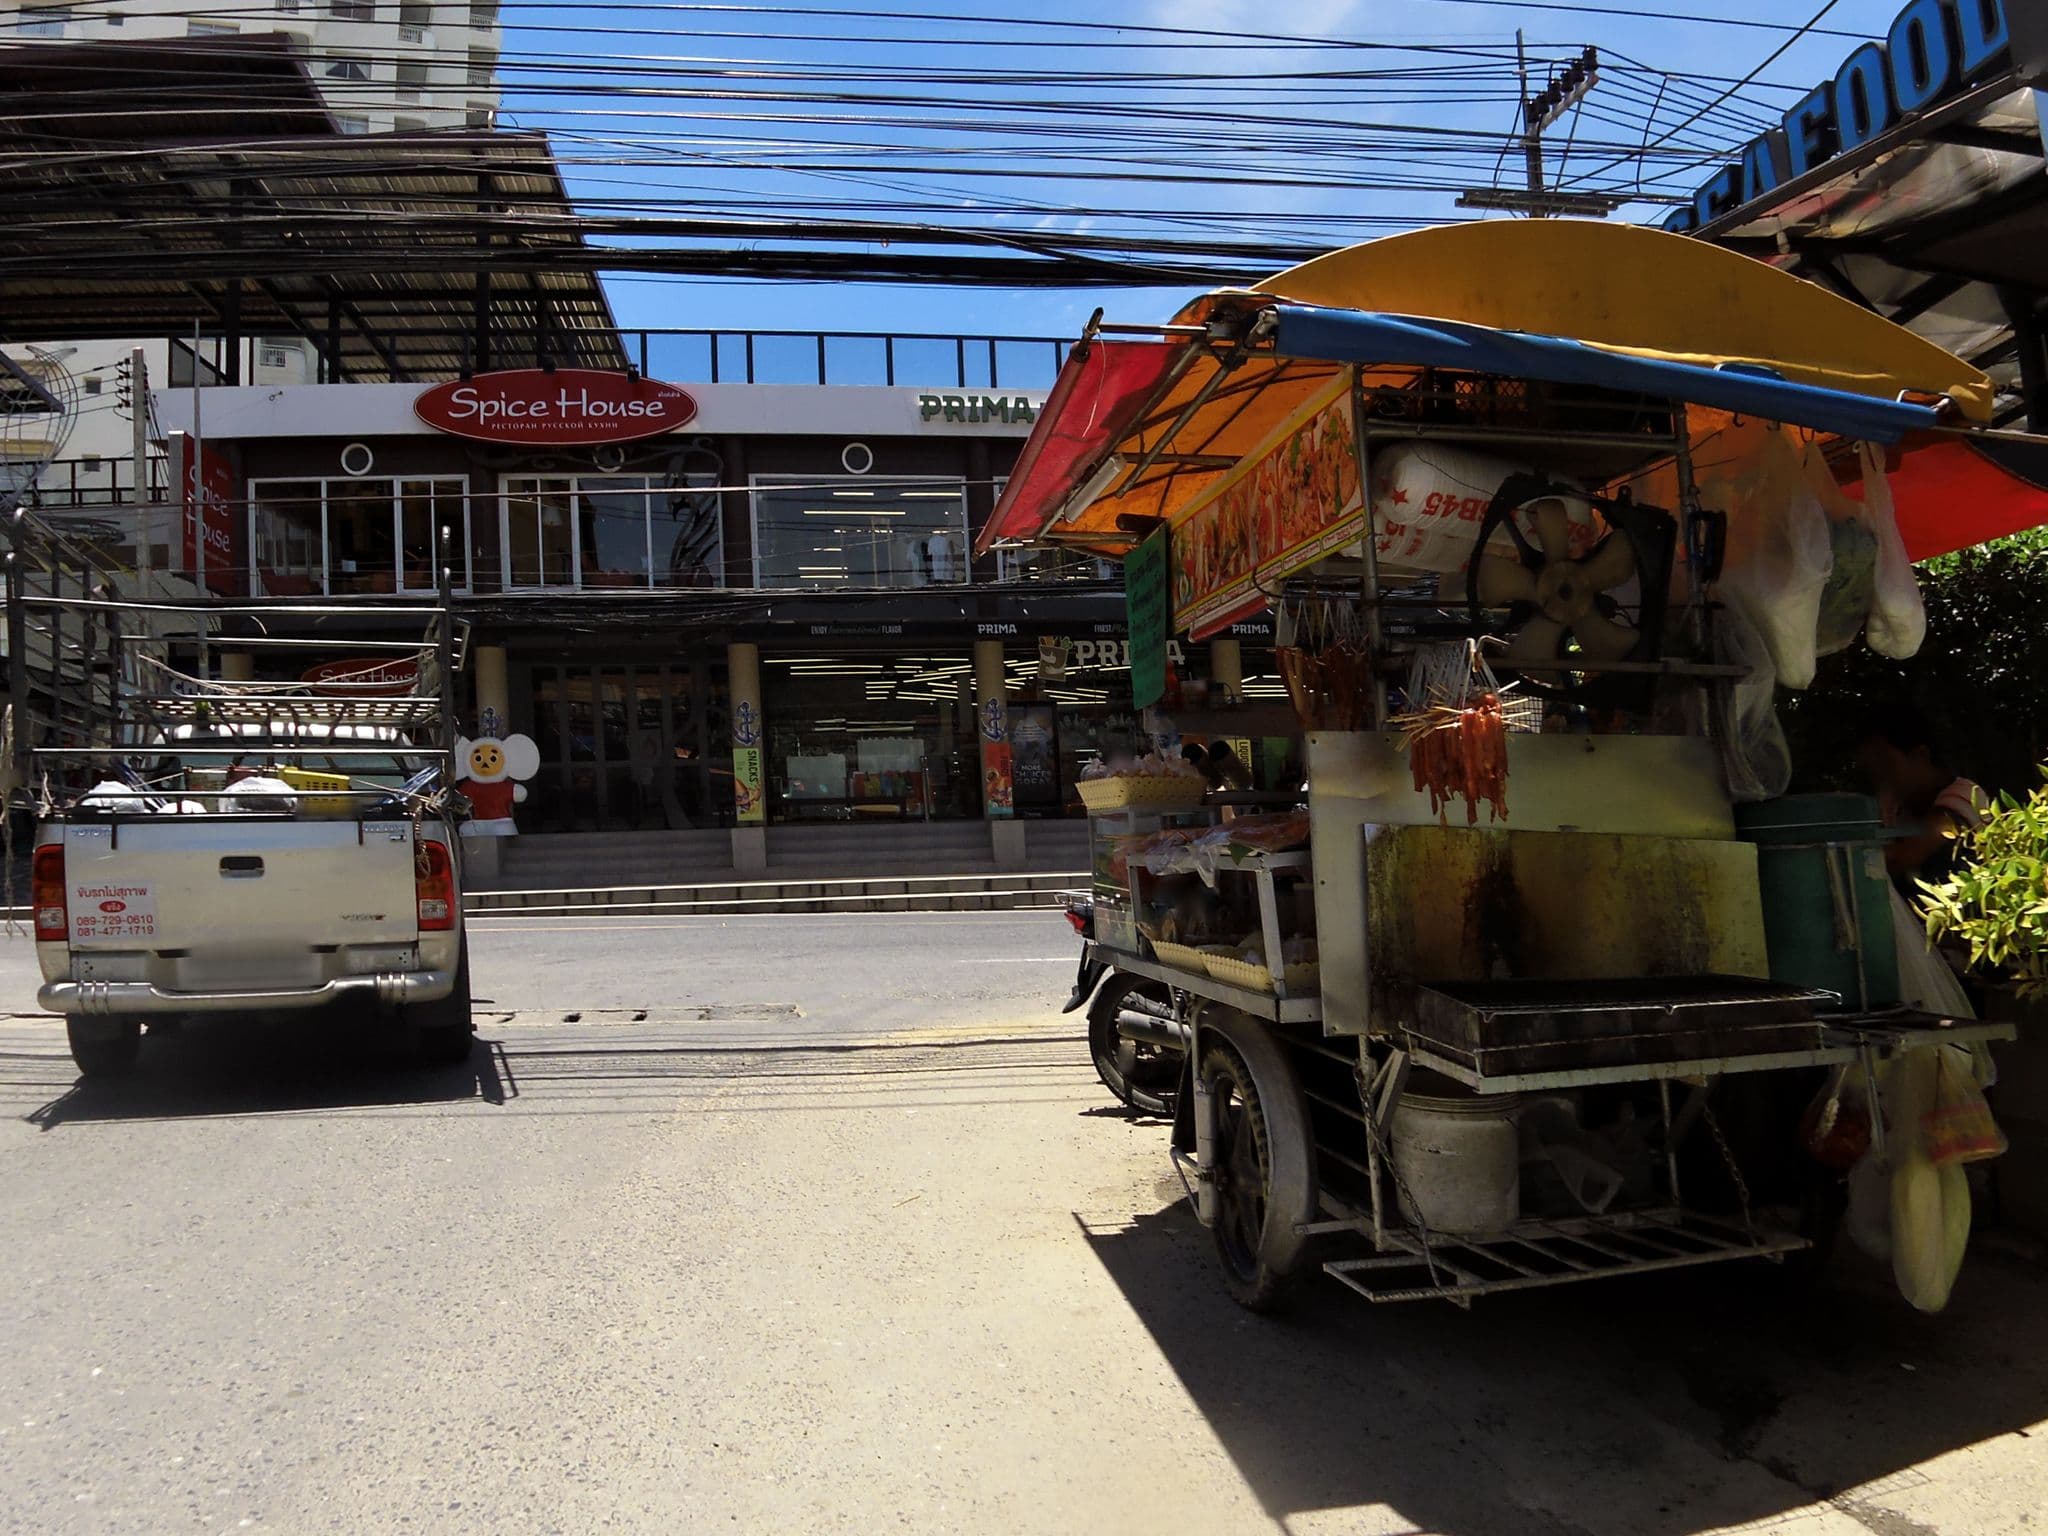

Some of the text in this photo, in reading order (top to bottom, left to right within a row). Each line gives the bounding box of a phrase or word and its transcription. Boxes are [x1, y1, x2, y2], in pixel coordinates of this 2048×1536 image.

[448, 388, 666, 425] Spice House
[919, 394, 1035, 424] PRIMA
[977, 623, 1017, 635] PRIMA
[1232, 623, 1269, 634] PRIMA
[1074, 640, 1185, 666] PRIA
[368, 668, 417, 683] Hous
[747, 750, 759, 782] SNACKS
